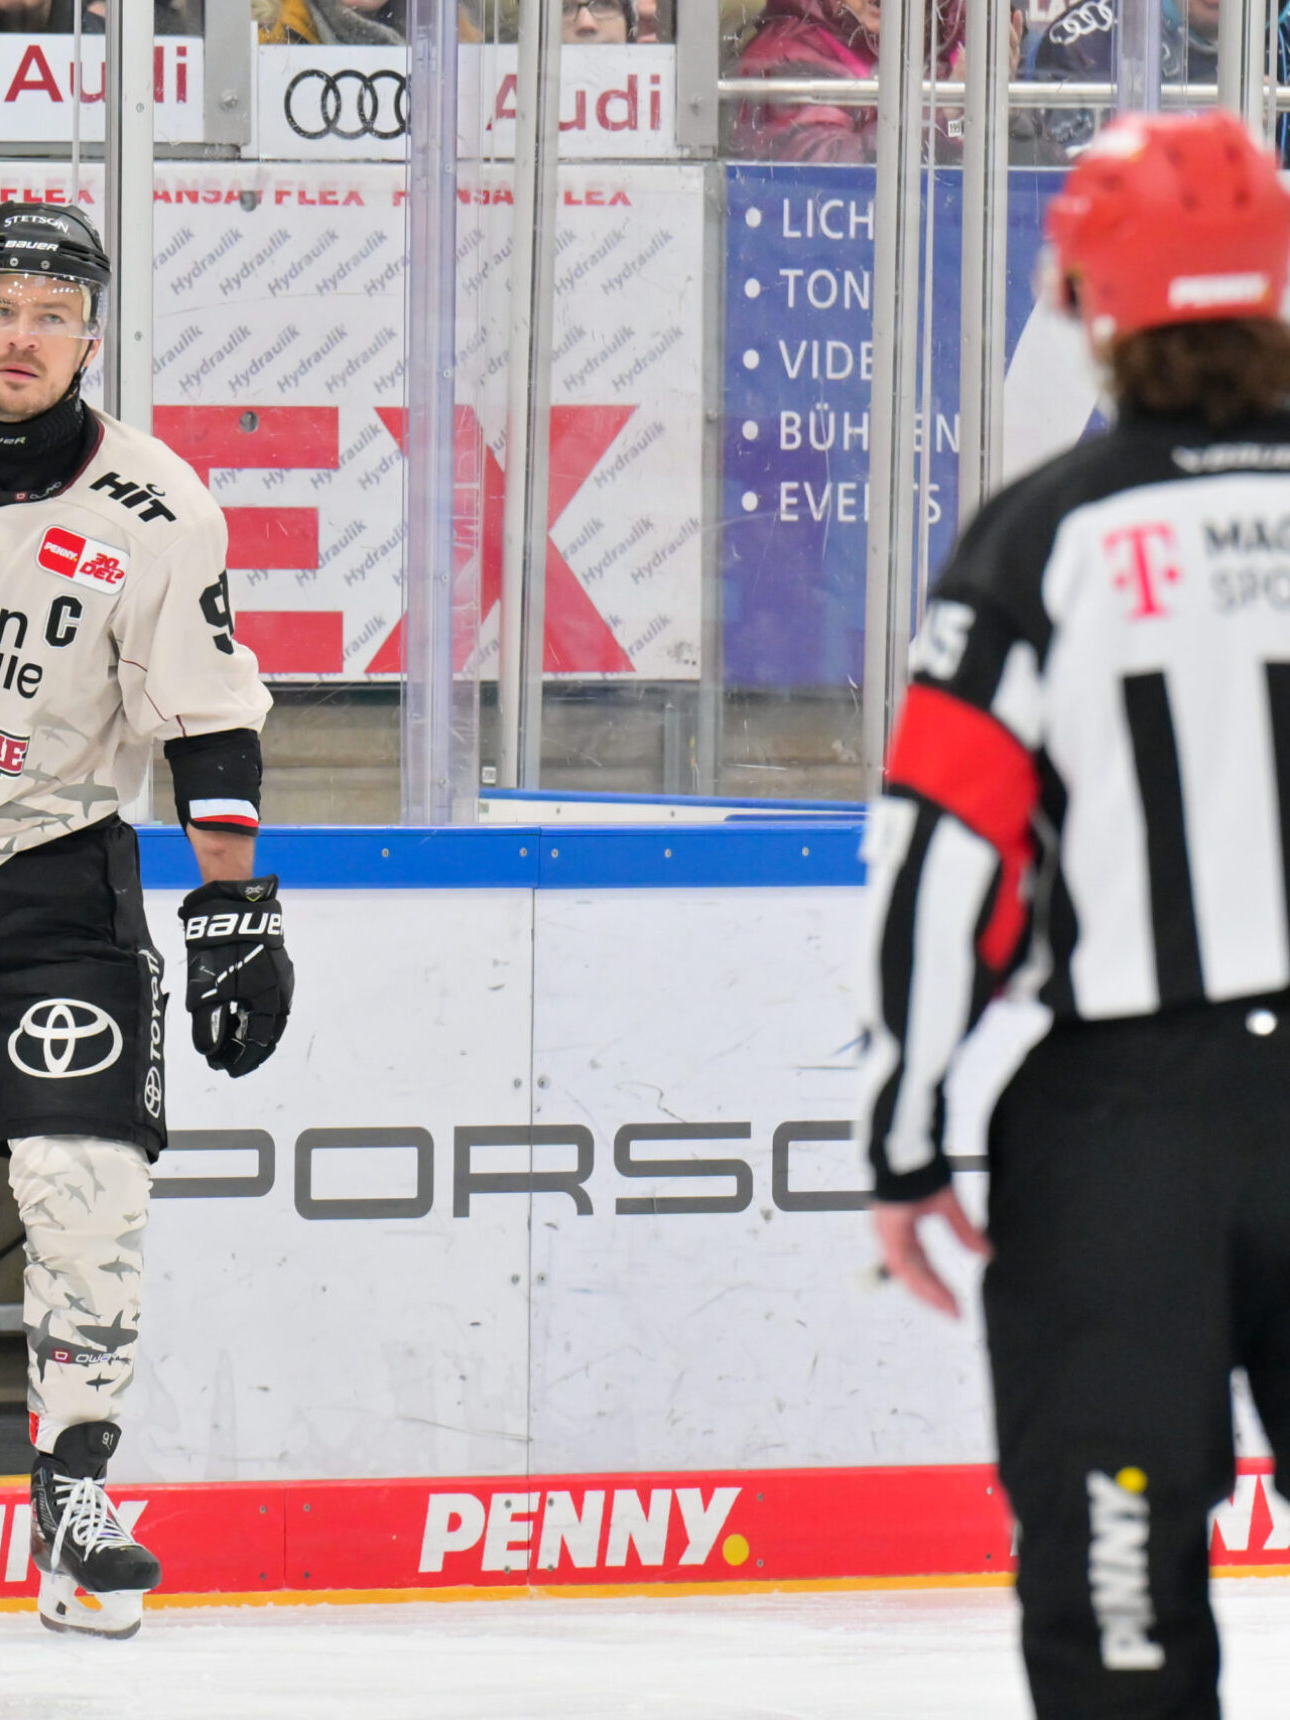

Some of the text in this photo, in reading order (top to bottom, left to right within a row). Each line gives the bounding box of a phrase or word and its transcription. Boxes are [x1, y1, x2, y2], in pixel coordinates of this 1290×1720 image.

[4, 215, 69, 233] STETSON
[5, 240, 60, 252] BAUER
[153, 226, 196, 270] raulik
[784, 198, 874, 240] LICH
[170, 228, 244, 296] Hydraulik
[218, 228, 292, 296] Hydraulik
[267, 229, 340, 297] Hydraulik
[315, 229, 389, 297] Hydraulik
[554, 229, 625, 296] Hydraulik
[600, 229, 673, 296] Hydraulik
[153, 324, 203, 375] draulik
[179, 324, 252, 393] Hydraulik
[228, 324, 300, 394] Hydraulik
[276, 325, 349, 394] Hydraulik
[325, 326, 397, 394] Hydraulik
[563, 325, 636, 392] Hydraulik
[612, 326, 685, 392] Hydraulik
[779, 340, 873, 380] VIDE
[594, 419, 666, 489] Hydraulik
[780, 403, 961, 453] BÜHEN
[89, 472, 177, 523] HIT
[780, 482, 941, 525] EVES
[343, 521, 408, 587] Hydrauli
[563, 516, 605, 561] raulik
[581, 516, 654, 585] Hydraulik
[630, 517, 701, 586] Hydraulik
[79, 561, 125, 585] DEL
[45, 595, 83, 648] C
[342, 615, 387, 661] raulik
[628, 613, 671, 659] raulik
[186, 912, 284, 941] BAUE
